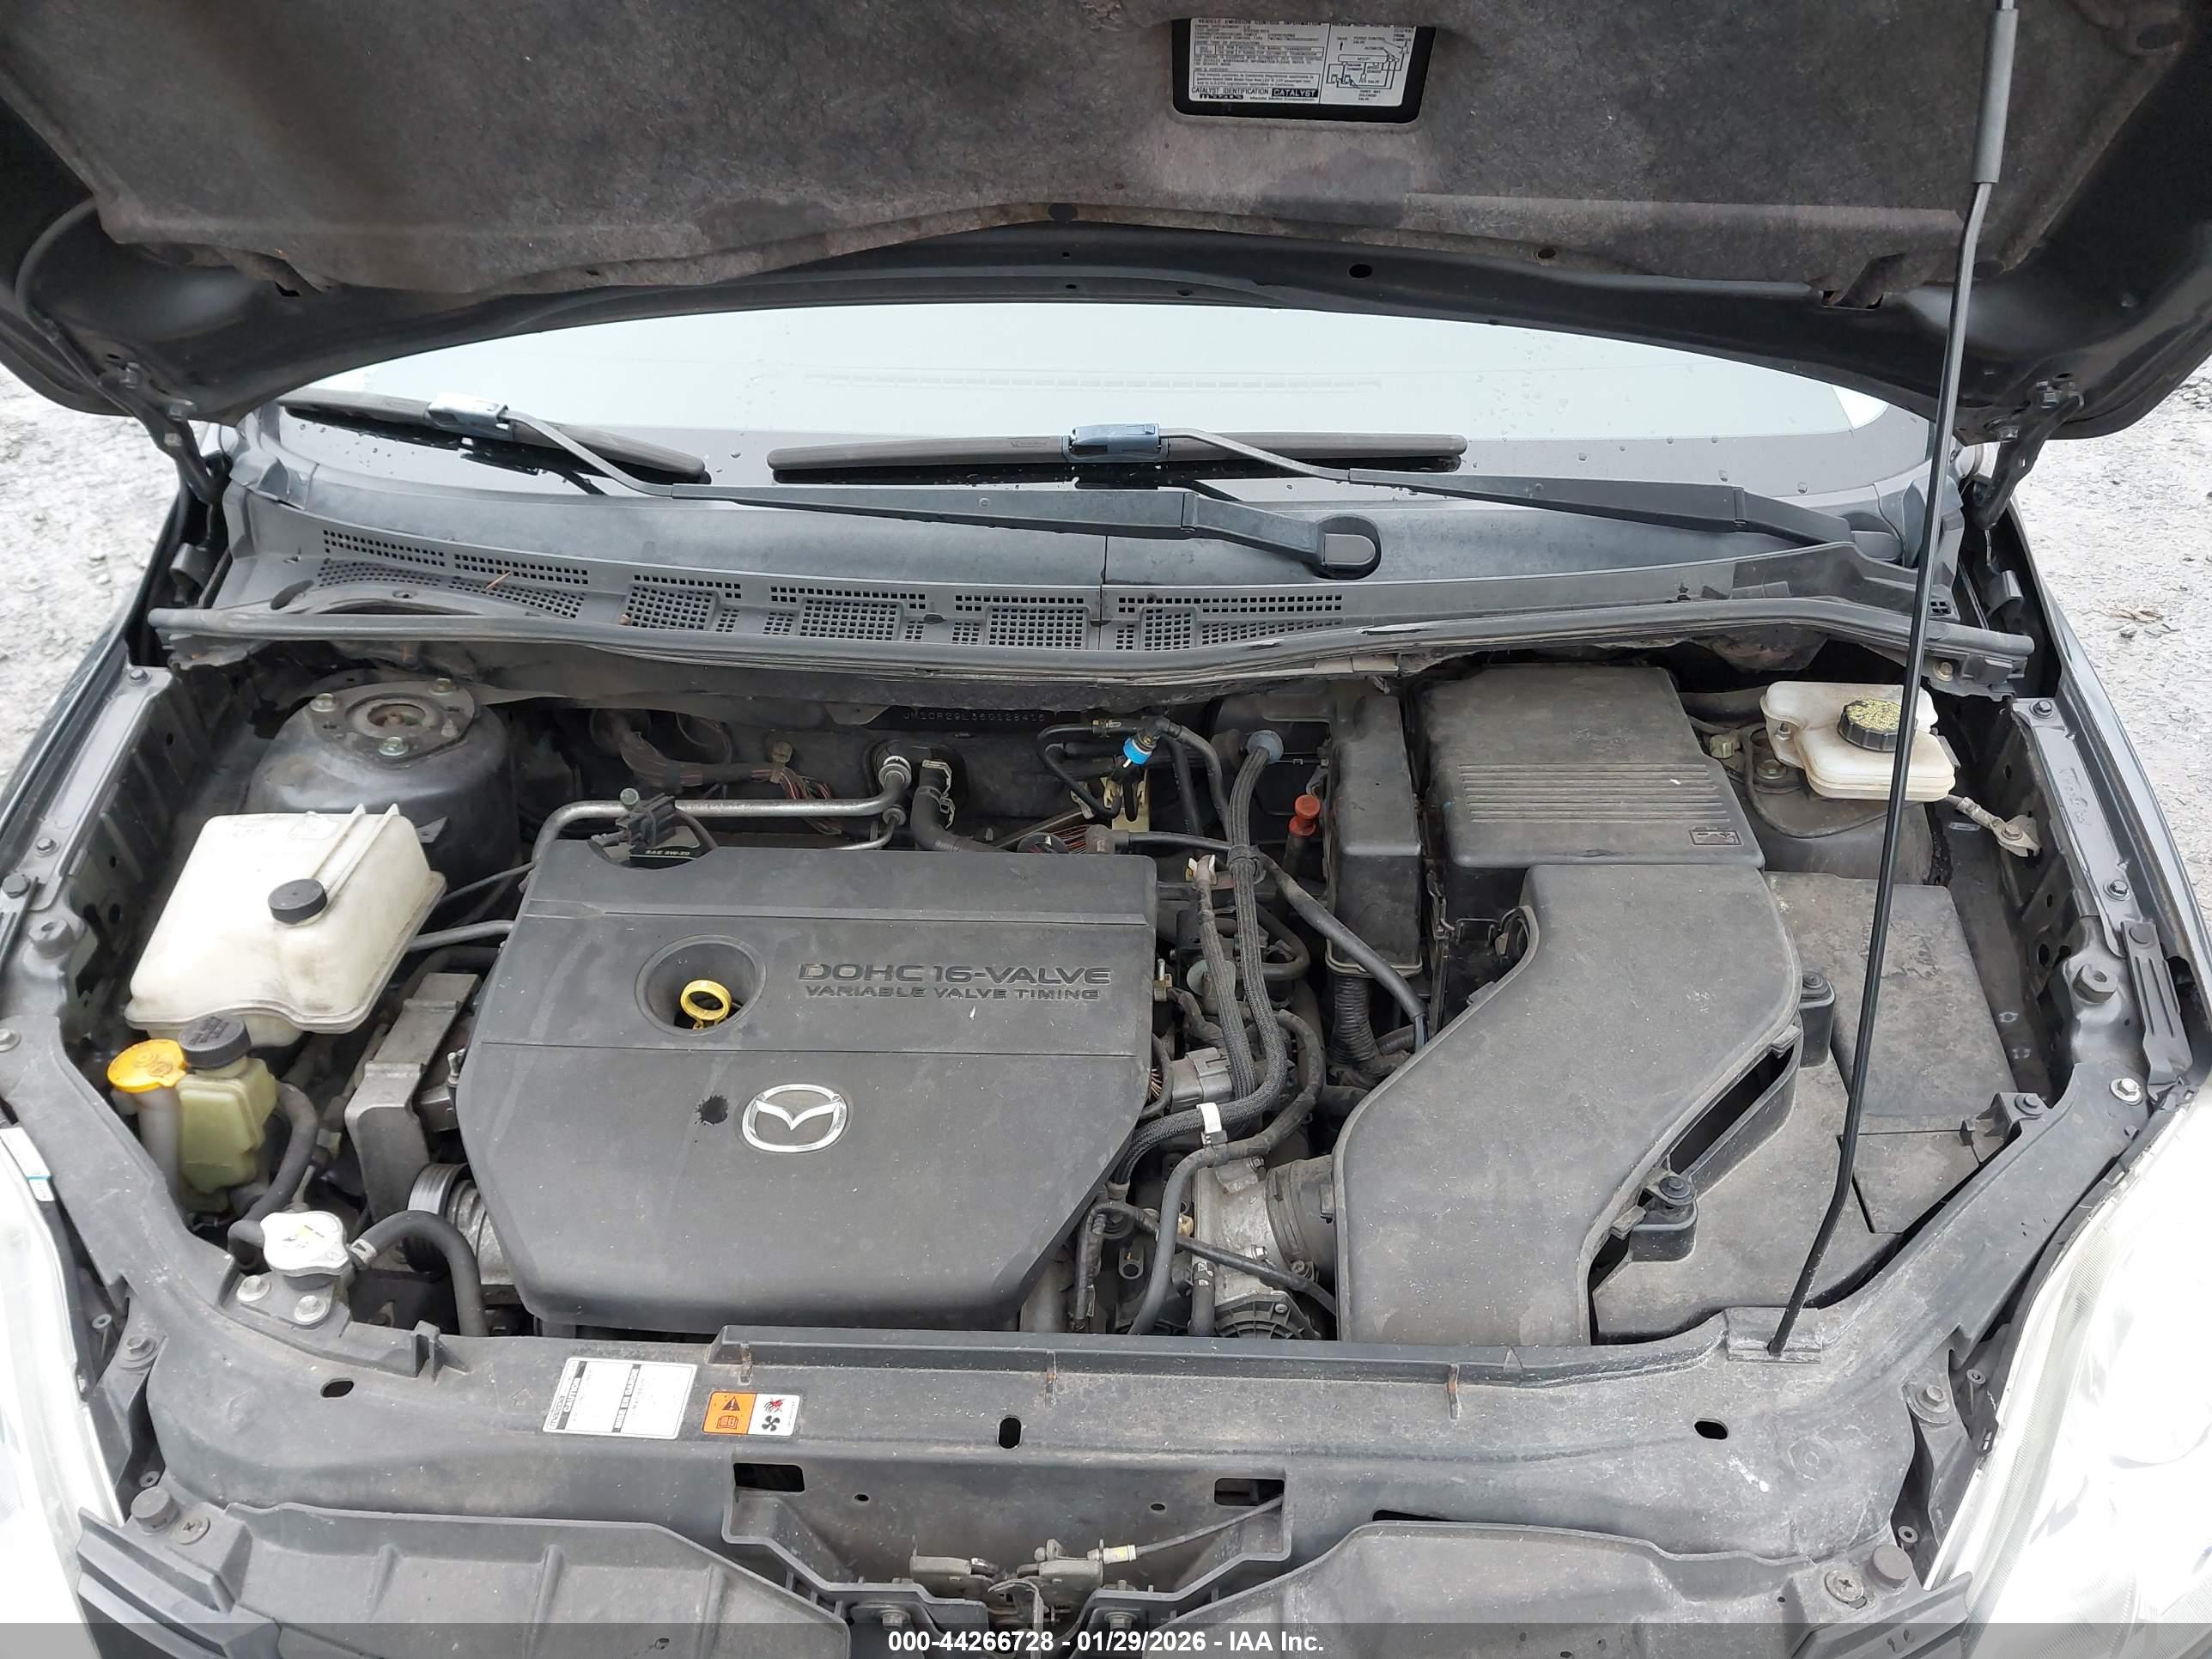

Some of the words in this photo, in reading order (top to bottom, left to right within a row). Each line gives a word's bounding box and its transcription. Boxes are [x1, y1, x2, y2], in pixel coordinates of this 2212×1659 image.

[1223, 87, 1269, 95] IDENTIFICATION
[1273, 88, 1316, 97] CATALYST
[799, 963, 925, 981] DOHC
[933, 965, 1112, 985] 16-VALVE
[806, 985, 927, 999] VARIABLE
[933, 987, 1007, 1000] VALVE
[1015, 988, 1100, 1000] TIMING
[563, 1377, 581, 1413] CAUTION
